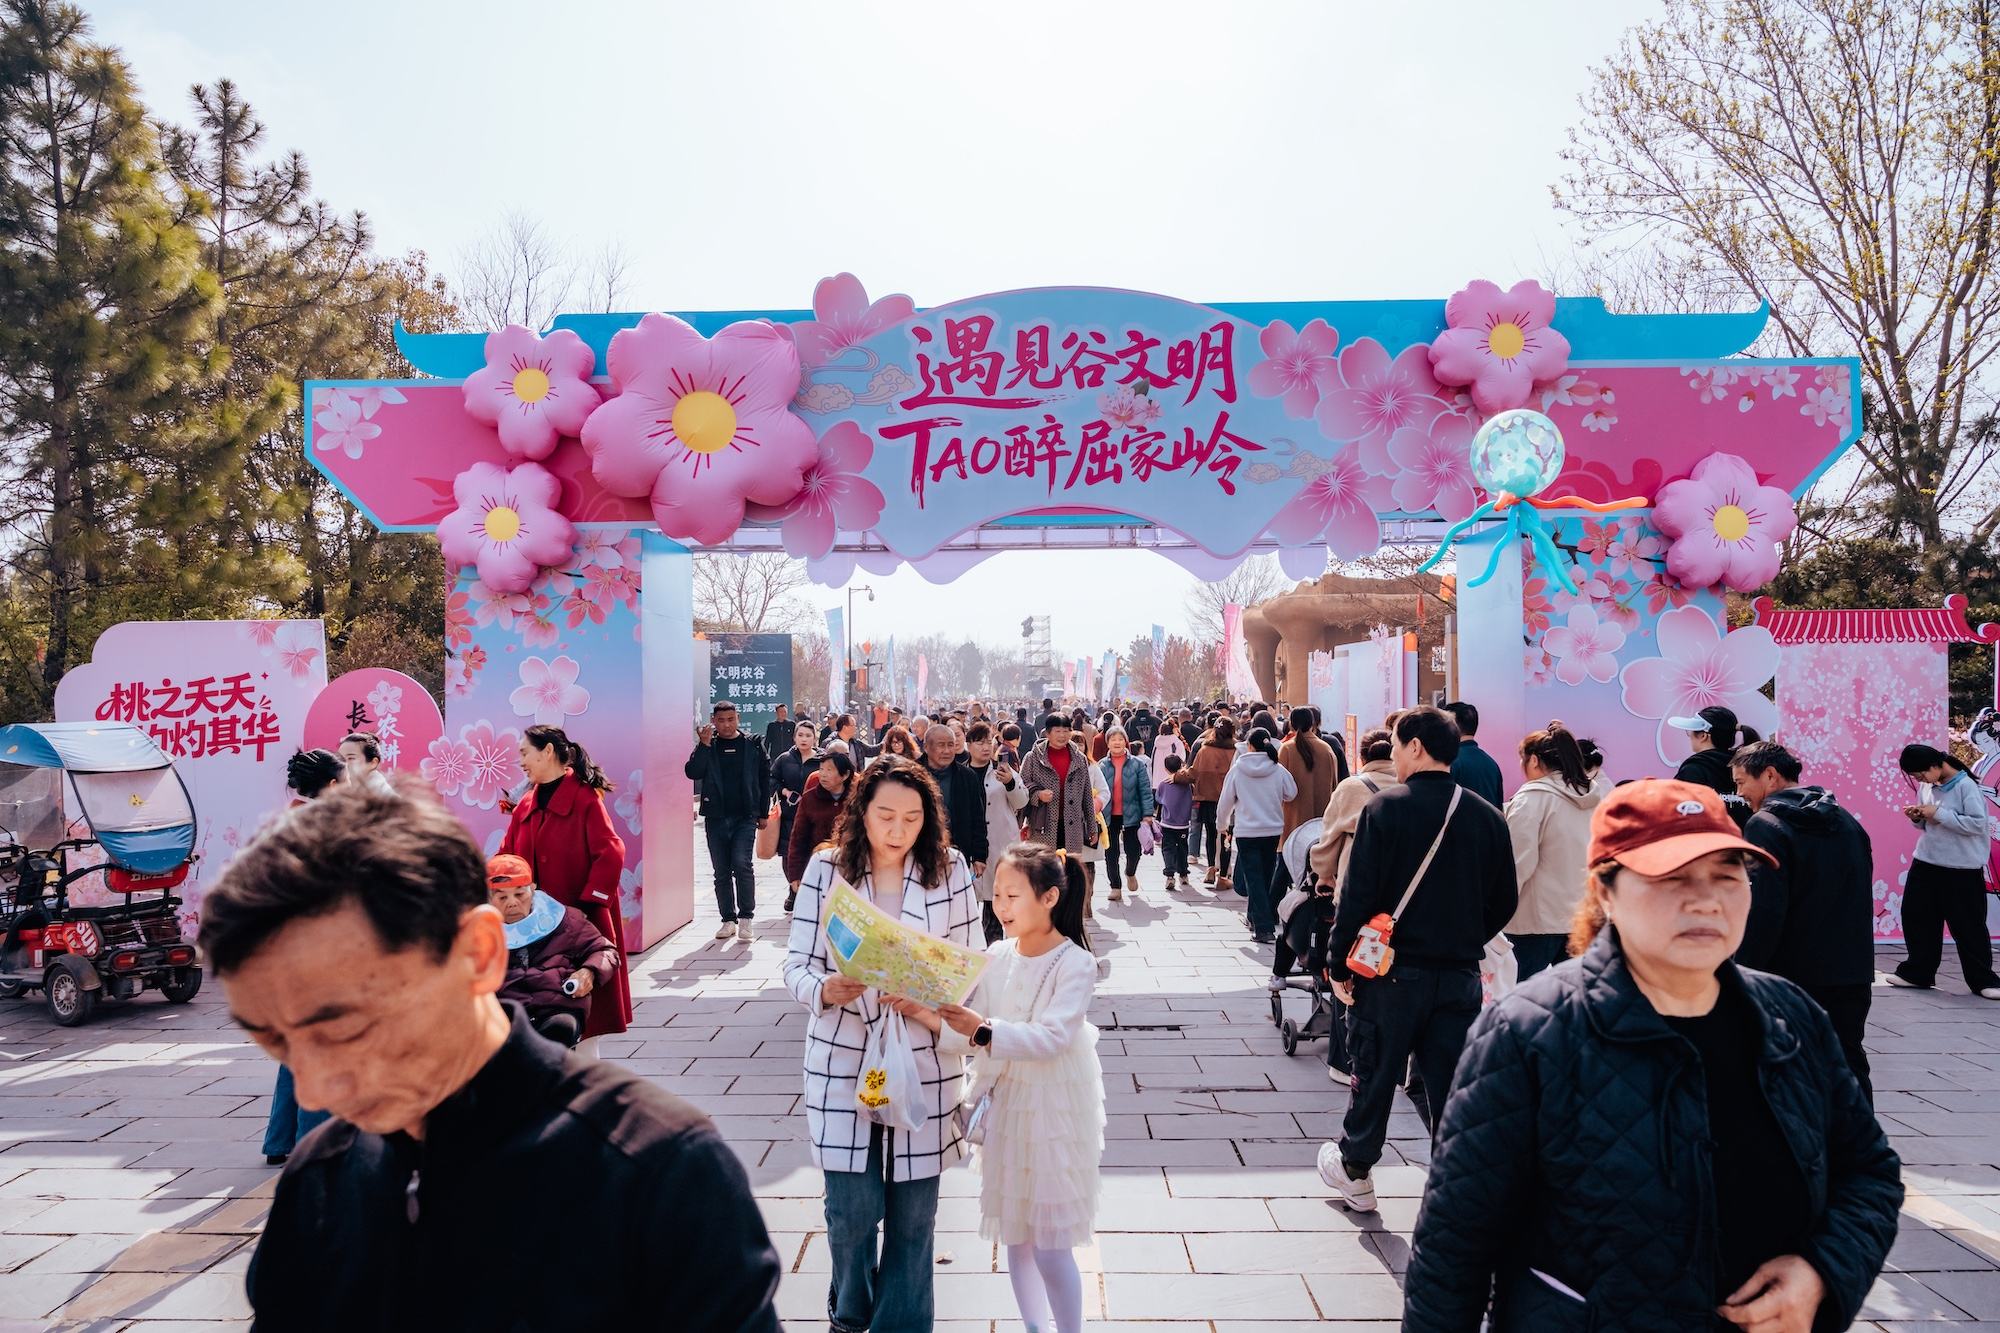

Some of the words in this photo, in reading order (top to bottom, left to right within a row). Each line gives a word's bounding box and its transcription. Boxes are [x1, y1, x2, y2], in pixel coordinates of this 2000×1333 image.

[878, 411, 1267, 510] TAO醉屈家岭
[715, 665, 766, 680] 文明农谷
[728, 683, 778, 697] 数字农谷
[345, 699, 374, 734] 长
[376, 713, 405, 780] 农耕
